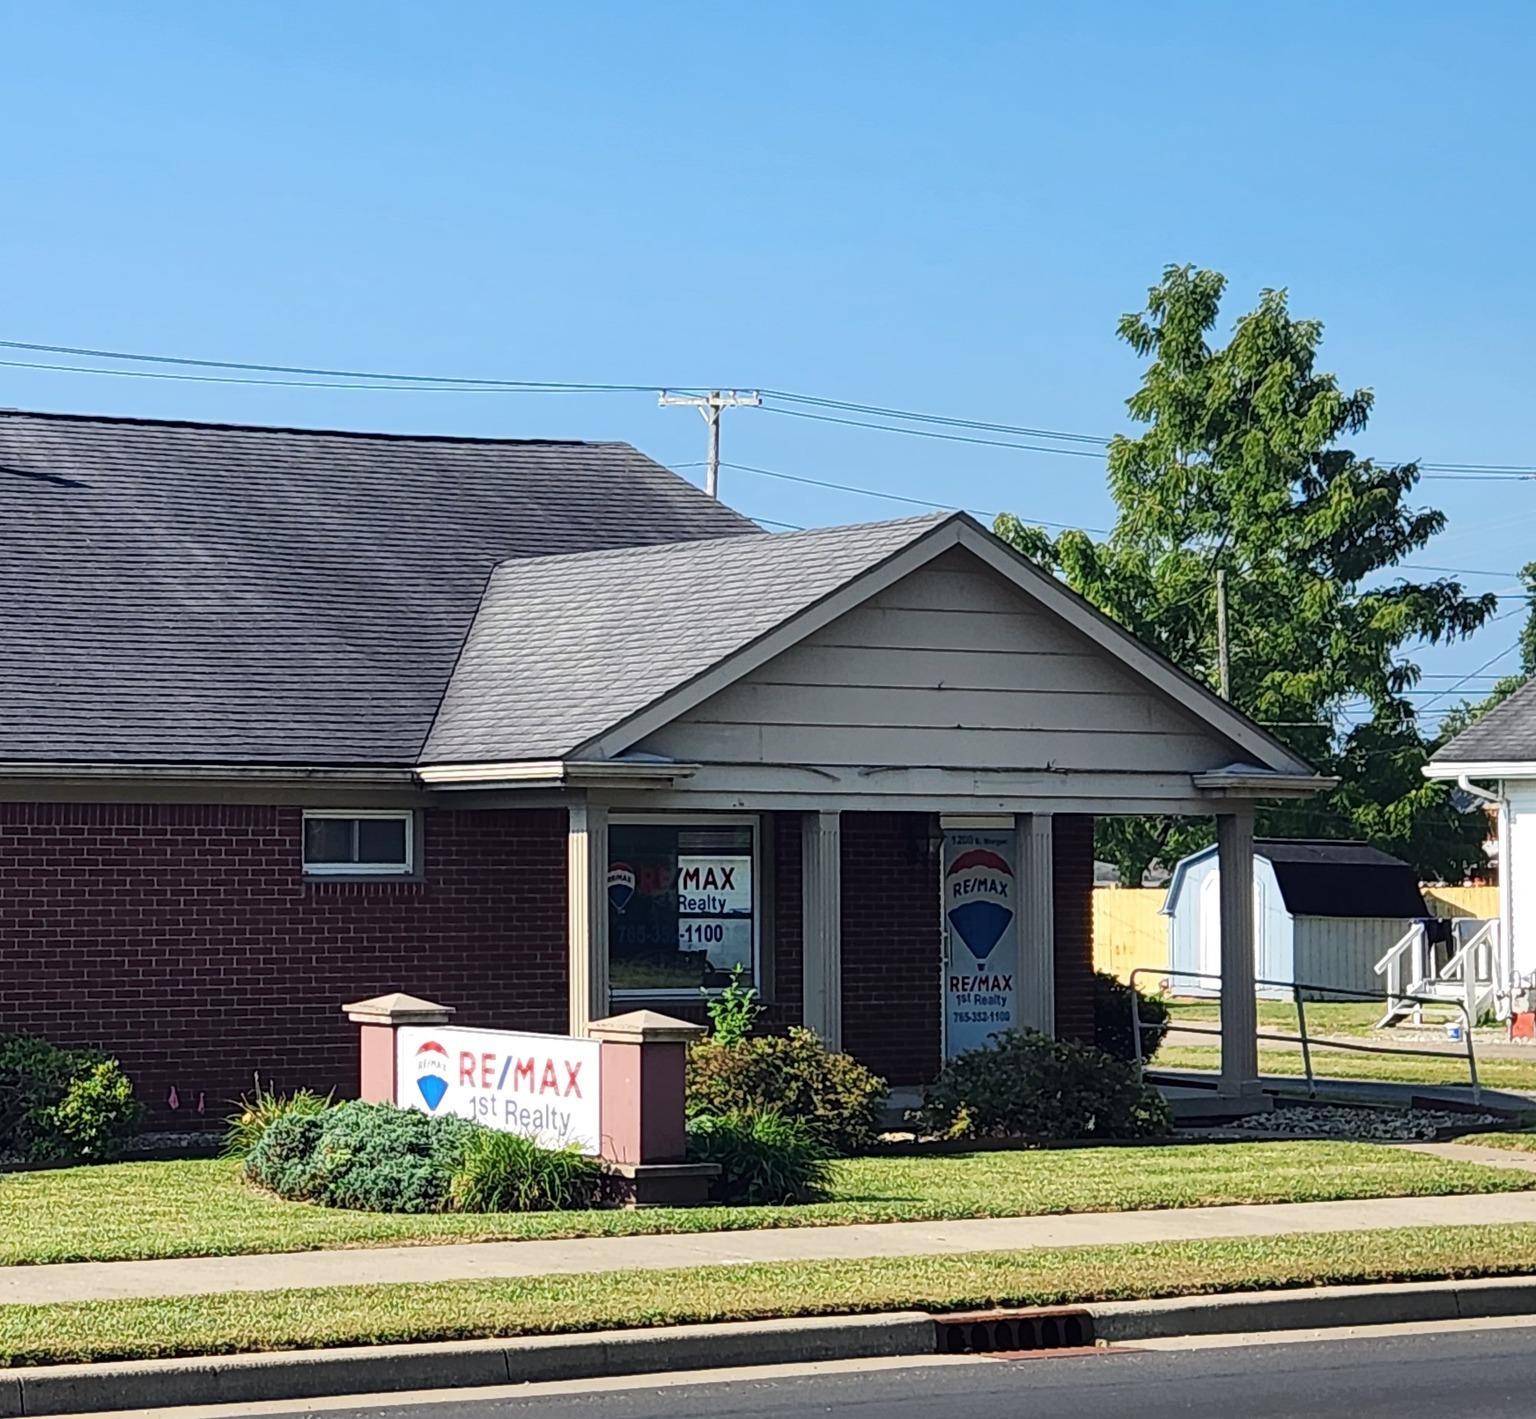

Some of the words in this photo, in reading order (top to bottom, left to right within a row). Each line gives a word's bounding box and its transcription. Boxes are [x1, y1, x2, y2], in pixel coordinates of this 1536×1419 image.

[953, 877, 1008, 898] RE/MAX
[678, 894, 726, 914] Realty
[949, 974, 1013, 993] RE/MAX
[956, 993, 972, 1007] 1st
[974, 993, 1007, 1008] Realty
[418, 1059, 447, 1072] RE/MAX
[459, 1051, 583, 1099] RE/MAX
[469, 1093, 497, 1119] 1st
[505, 1099, 571, 1137] Realty
